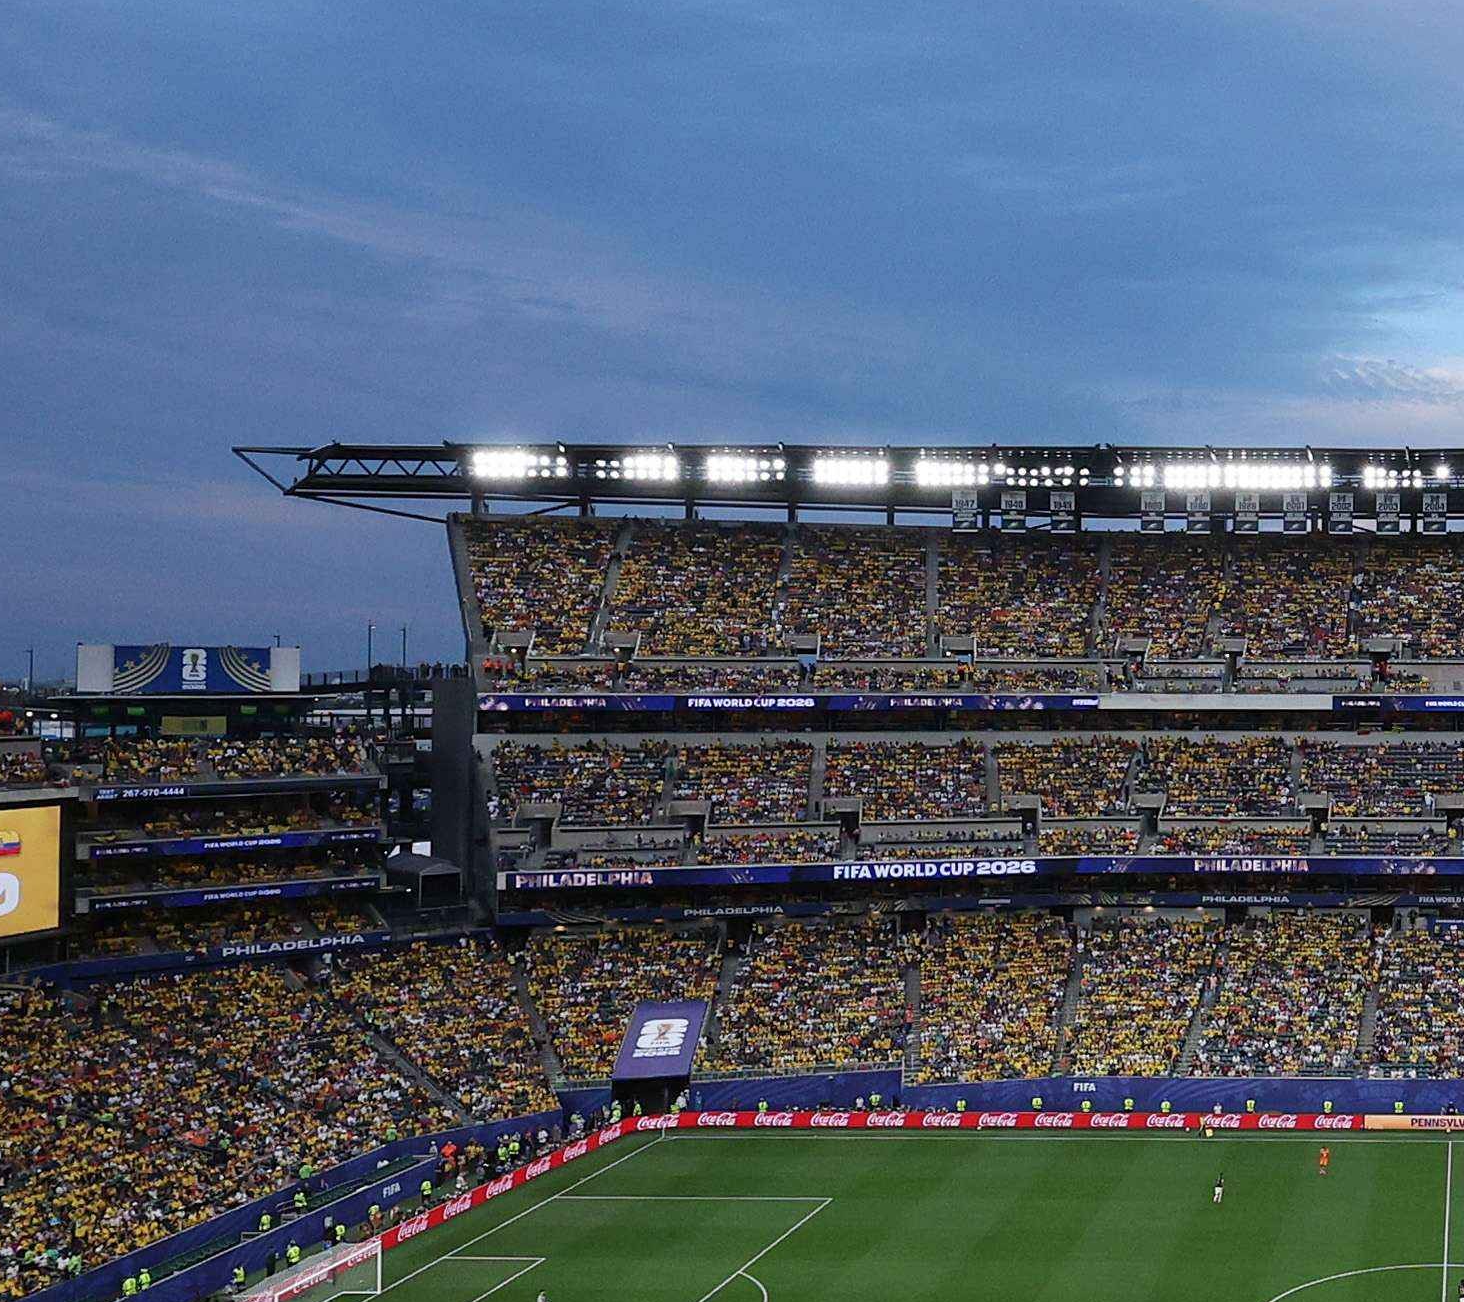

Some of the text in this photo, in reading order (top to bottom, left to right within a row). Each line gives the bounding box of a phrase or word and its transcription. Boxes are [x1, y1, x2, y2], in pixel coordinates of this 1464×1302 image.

[688, 698, 712, 707] FIFA
[713, 698, 753, 707] WORLD
[754, 698, 776, 707] CUP
[833, 860, 1036, 879] FIFA WORLD CUP 2026
[1194, 860, 1308, 872] PHILADELPHIA
[516, 872, 653, 888] PHILADELPHIA
[684, 905, 784, 917] PHILADELPHIA
[222, 934, 365, 957] PHILADELPHIA
[1073, 1082, 1096, 1093] FIFA
[383, 1182, 401, 1198] FIFA
